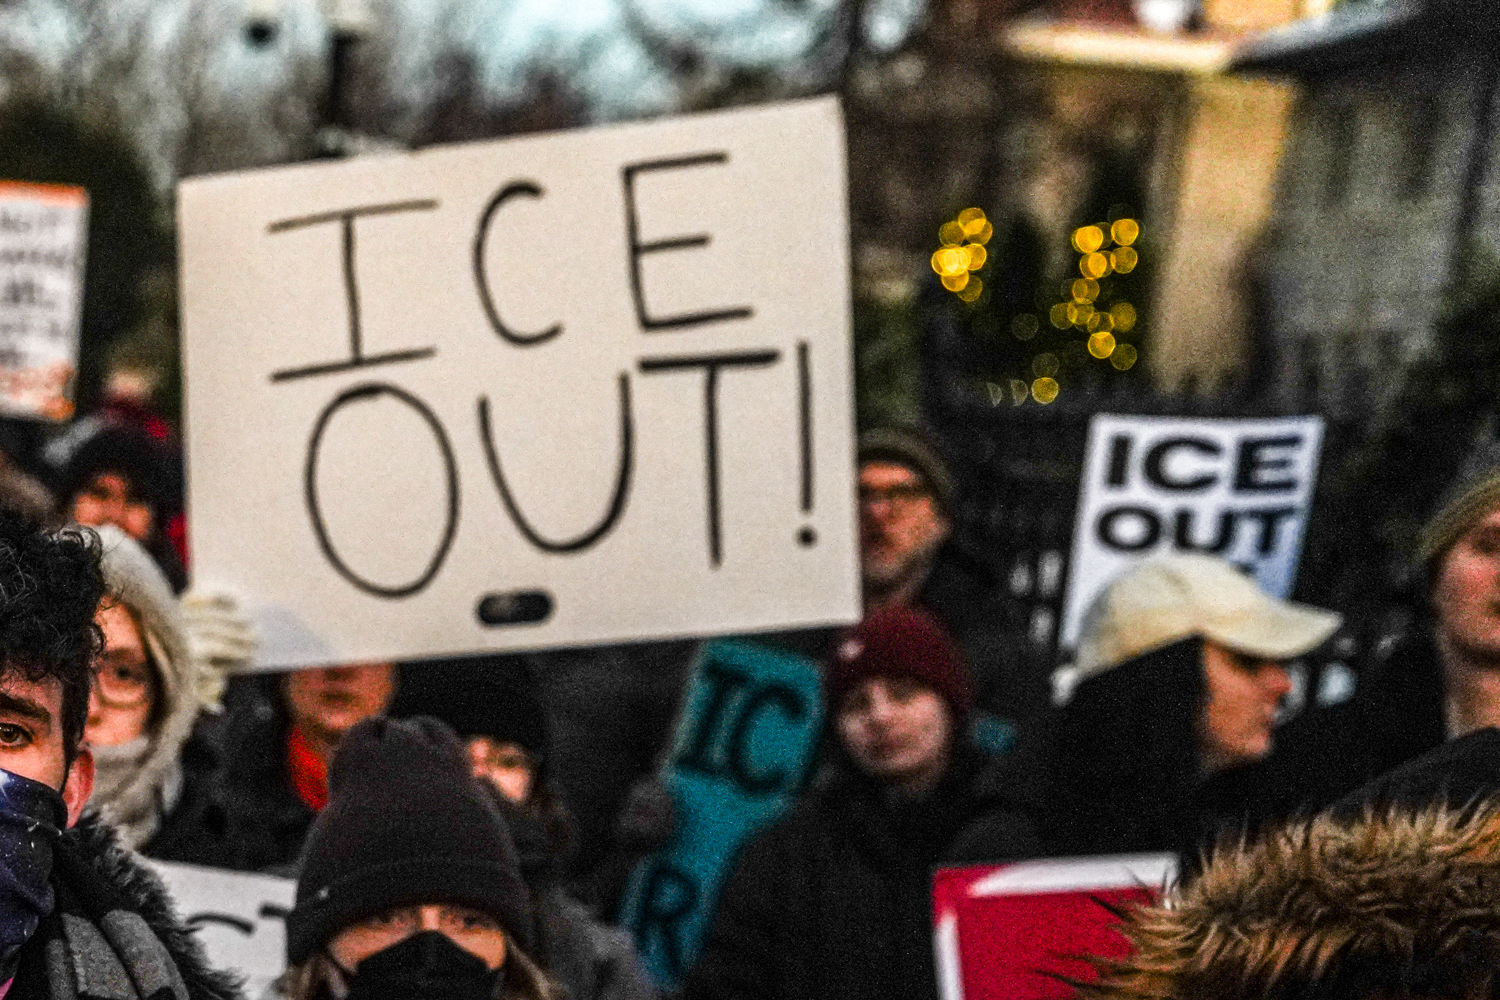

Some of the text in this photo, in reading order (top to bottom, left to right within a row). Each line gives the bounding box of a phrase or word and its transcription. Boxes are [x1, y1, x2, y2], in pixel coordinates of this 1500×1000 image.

[267, 150, 753, 384] ICE
[306, 338, 818, 600] OUT!
[1095, 503, 1298, 559] OUT
[1104, 434, 1303, 495] ICE
